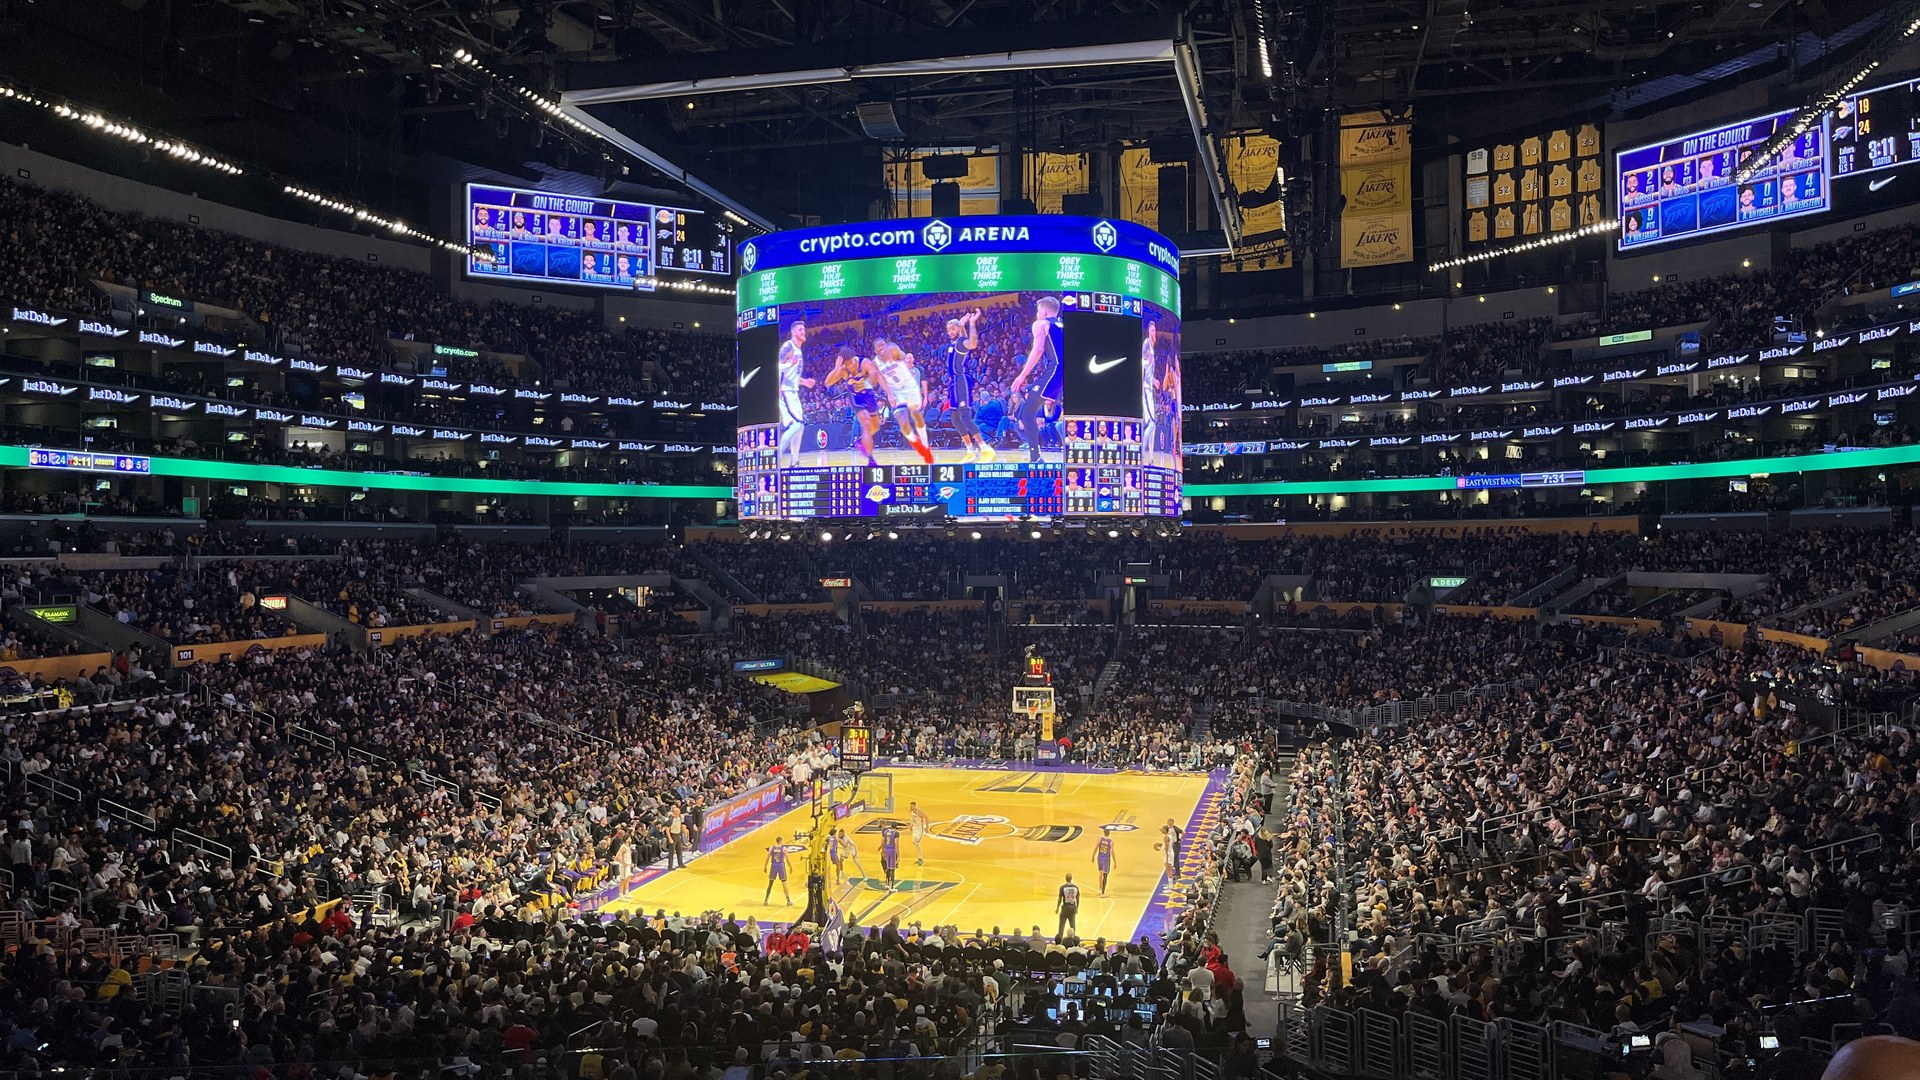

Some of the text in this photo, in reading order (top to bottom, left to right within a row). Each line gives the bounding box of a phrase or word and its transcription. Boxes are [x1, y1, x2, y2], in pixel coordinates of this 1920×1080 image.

[1858, 98, 1870, 114] 19
[1858, 119, 1870, 136] 24
[1581, 137, 1595, 146] 25
[1683, 125, 1752, 156] ON THE COURT
[1805, 132, 1812, 147] 3
[1525, 147, 1537, 156] 13
[1553, 142, 1565, 151] 44
[1868, 136, 1896, 160] 3:11
[1237, 146, 1277, 160] LAKERS
[1471, 151, 1483, 161] 99
[1498, 152, 1510, 161] 22
[1894, 154, 1898, 163] 1
[1722, 153, 1729, 167] 3
[1038, 163, 1075, 177] LAKERS
[1684, 162, 1690, 176] 5
[1554, 178, 1566, 186] 32
[1582, 173, 1595, 181] 42
[1646, 171, 1653, 185] 2
[1805, 172, 1813, 187] 4
[1356, 180, 1396, 196] LAKERS
[1498, 186, 1511, 195] 52
[1764, 182, 1771, 196] 0
[533, 196, 595, 214] ON THE COURT
[1370, 193, 1398, 207] CHAMPIONS
[498, 211, 504, 223] 2
[534, 214, 540, 226] 5
[677, 213, 685, 226] 19
[1555, 212, 1566, 221] 24
[1647, 208, 1654, 221] 9
[569, 218, 576, 229] 3
[603, 222, 609, 233] 2
[1499, 220, 1510, 228] 34
[636, 226, 643, 237] 3
[676, 229, 686, 242] 24
[958, 226, 1030, 242] ARENA
[800, 229, 915, 254] crypto.com
[1356, 230, 1400, 247] LAKERS
[683, 247, 702, 264] 3:11
[1352, 246, 1402, 260] WORLD CHAMPIONS
[603, 255, 609, 266] 0
[636, 258, 643, 269] 4
[896, 259, 917, 268] OBEY
[976, 256, 999, 265] OBEY
[1059, 256, 1080, 265] OBEY
[822, 264, 841, 273] OBEY
[897, 266, 917, 275] YOUR
[977, 264, 997, 272] YOUR
[1061, 264, 1080, 273] YOUR
[823, 272, 840, 280] YOUR
[897, 282, 917, 291] Sprite
[977, 279, 998, 288] Sprite
[1060, 279, 1080, 288] Sprite
[823, 287, 841, 296] Sprite
[150, 293, 182, 308] Spectrum
[1080, 294, 1090, 308] 19
[1100, 295, 1117, 305] 3:11
[1133, 300, 1141, 313] 24
[743, 311, 754, 321] 3:11
[766, 307, 777, 321] 24
[1085, 422, 1091, 432] 2
[1113, 421, 1118, 430] 5
[1203, 445, 1216, 453] 24
[1505, 446, 1524, 459] KINGS
[38, 454, 48, 464] 19
[56, 454, 66, 465] 24
[72, 456, 91, 467] 3:11
[119, 460, 125, 468] 6
[136, 461, 142, 469] 5
[901, 466, 921, 475] 3:11
[871, 467, 884, 483] 19
[940, 466, 954, 481] 24
[1085, 469, 1091, 480] 2
[1103, 469, 1117, 477] 3:11
[769, 474, 775, 485] 3
[1543, 474, 1565, 484] 7:31
[1351, 524, 1531, 539] LOS ANGELES LAKERS
[178, 651, 192, 660] 101
[1032, 664, 1042, 674] 14
[849, 729, 868, 739] 3:11
